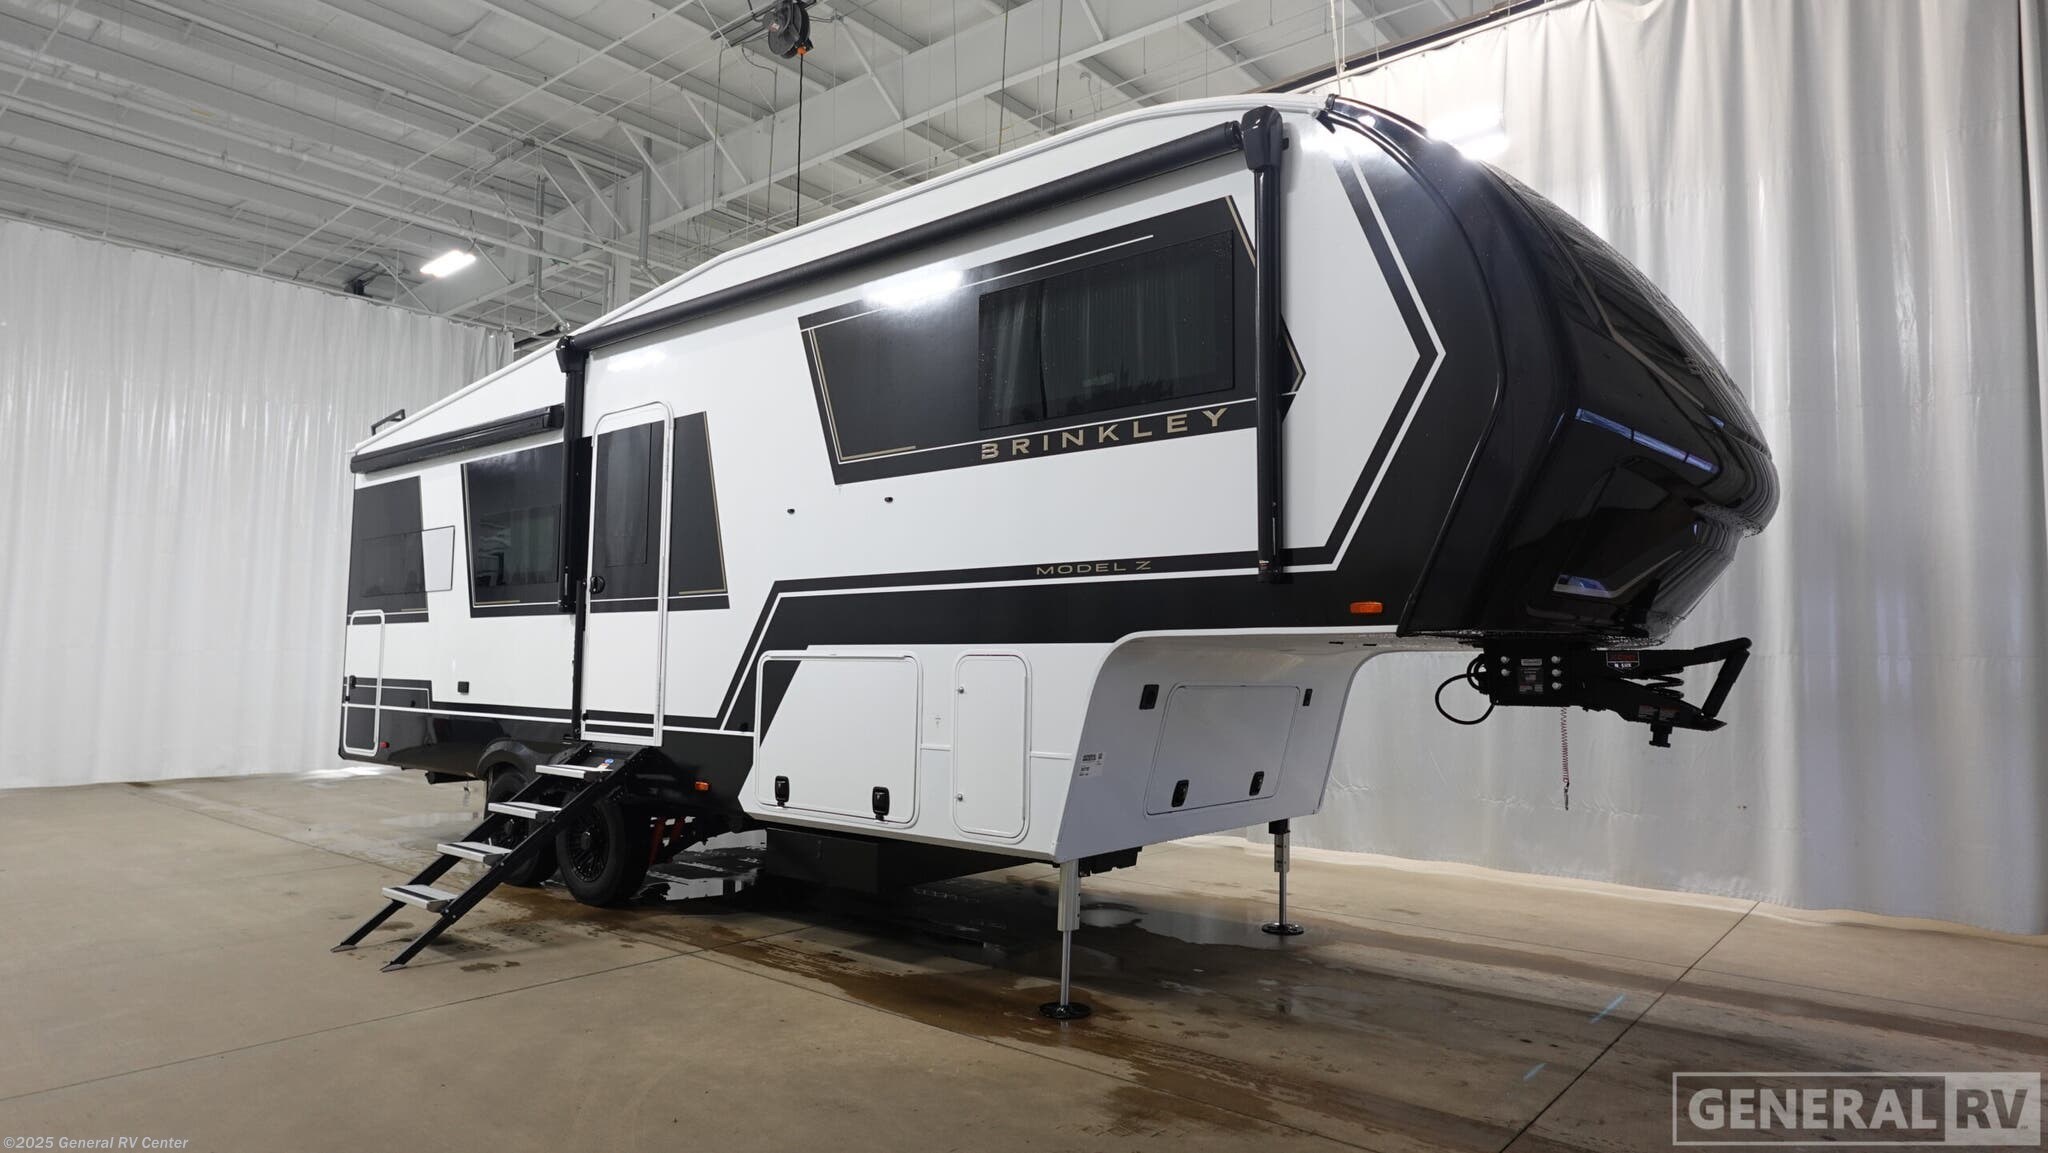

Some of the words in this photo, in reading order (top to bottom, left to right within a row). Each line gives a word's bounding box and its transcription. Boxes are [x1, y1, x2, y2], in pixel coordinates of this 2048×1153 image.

[981, 407, 1228, 461] BRINKLEY
[1036, 561, 1127, 576] MODEL
[1135, 560, 1152, 571] Z
